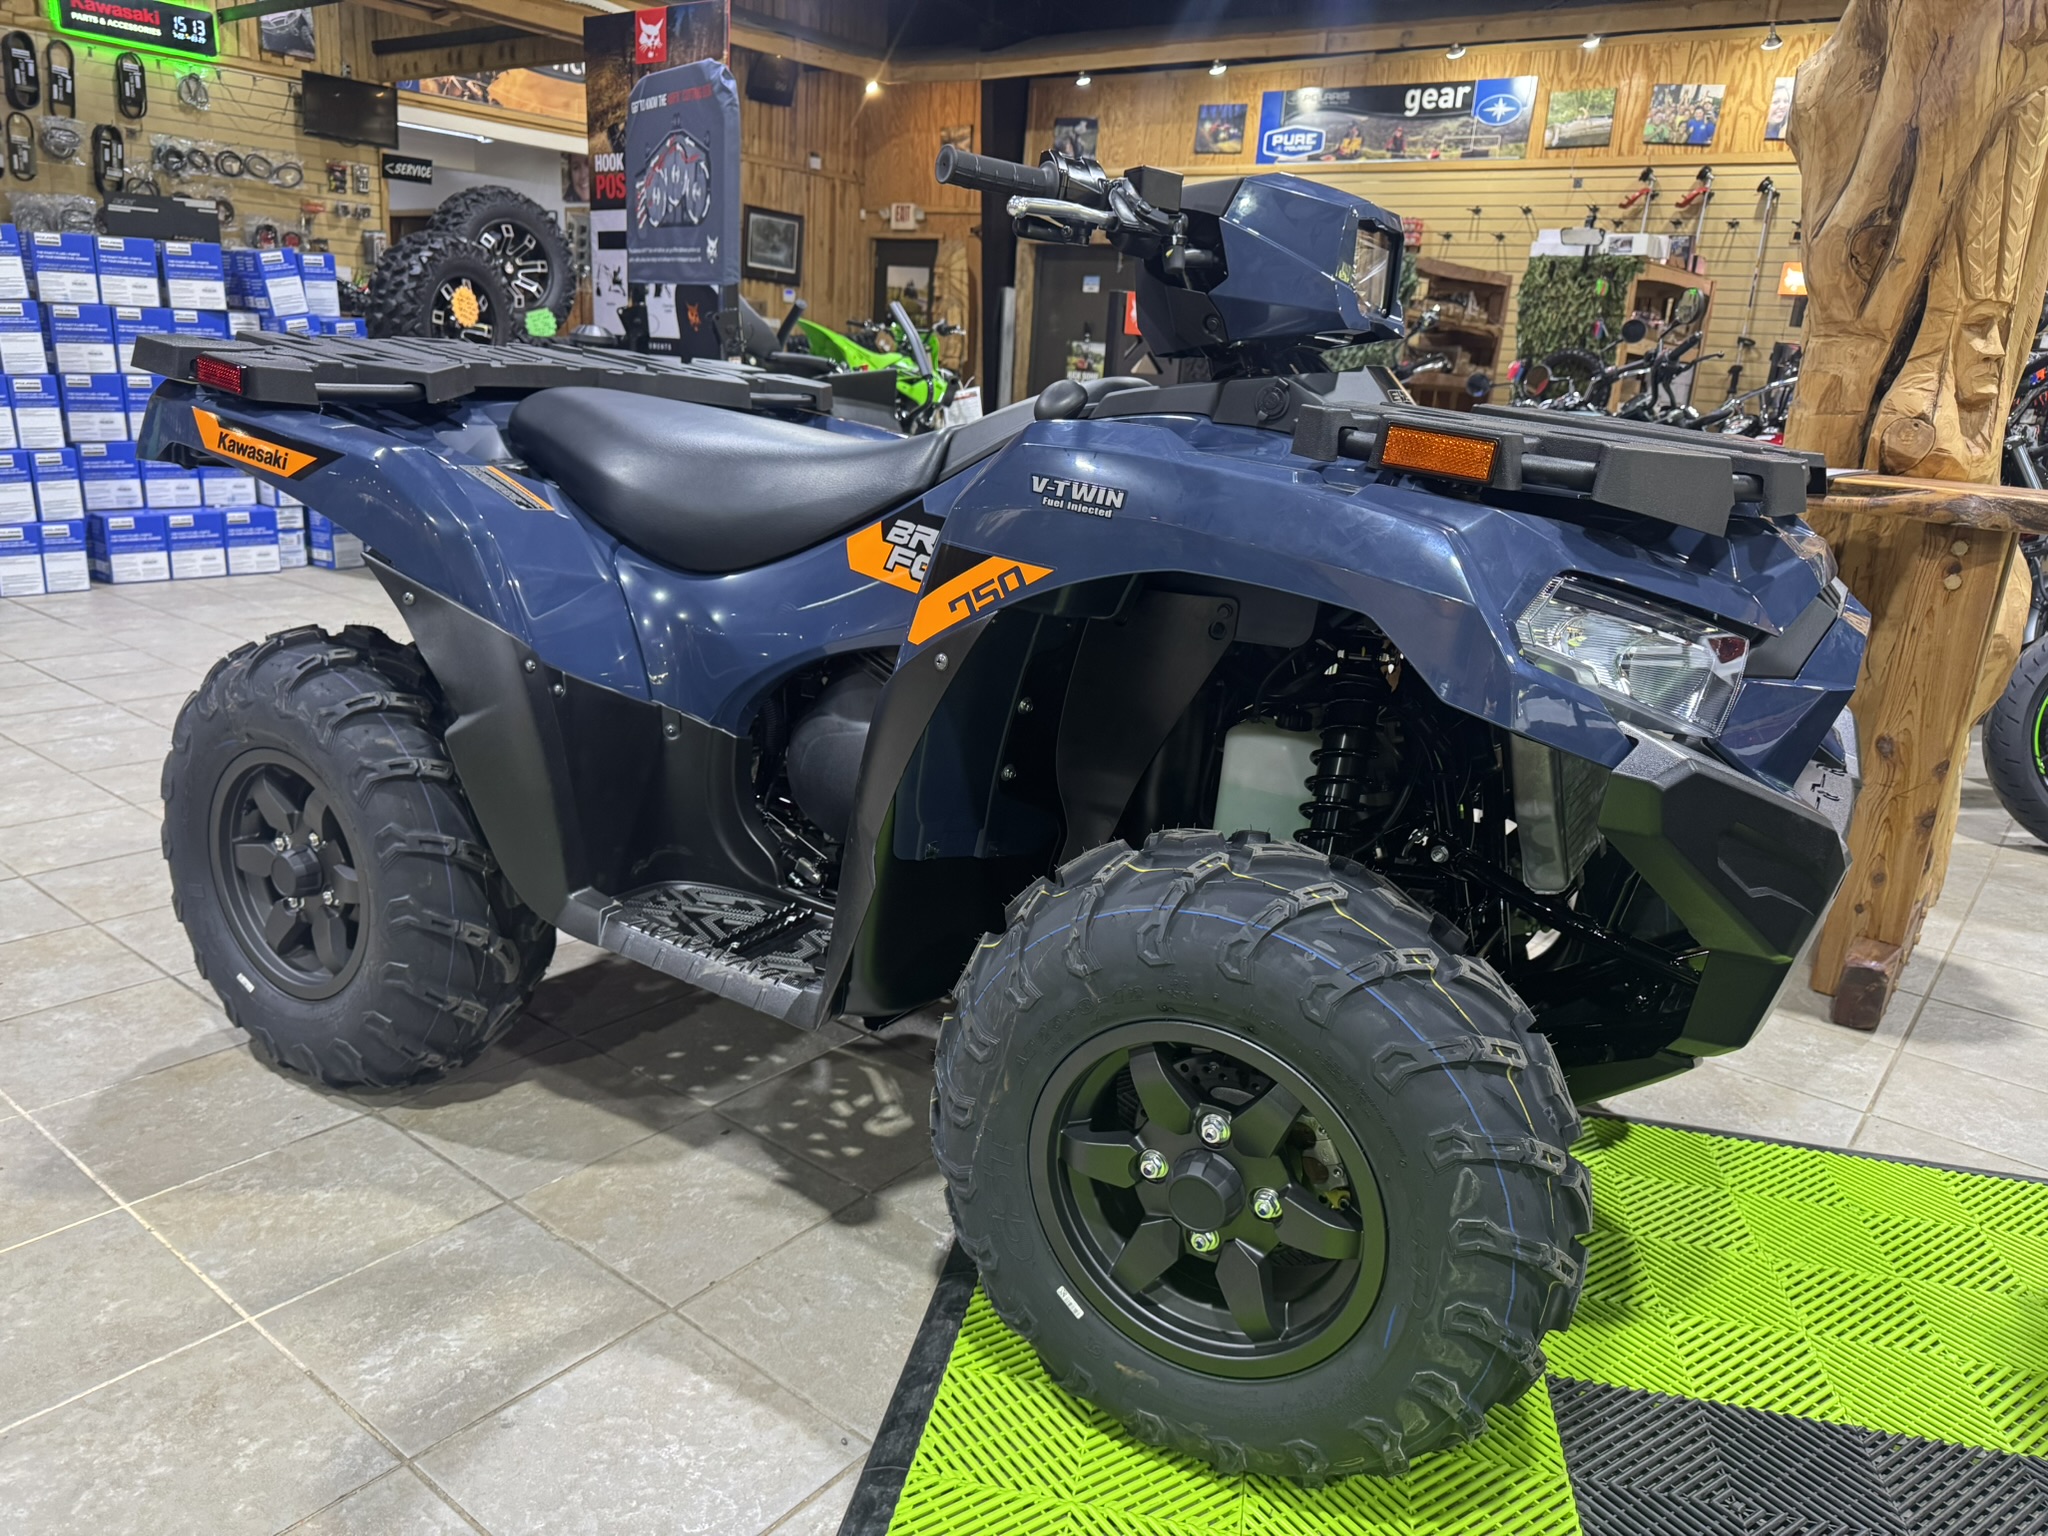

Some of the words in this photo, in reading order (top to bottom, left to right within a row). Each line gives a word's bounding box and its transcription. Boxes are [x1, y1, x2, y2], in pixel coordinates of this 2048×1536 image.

[70, 11, 99, 24] PARTS
[107, 18, 162, 37] ACCESSORIES
[1403, 85, 1472, 117] gear
[1271, 132, 1318, 147] PURE
[394, 162, 433, 179] SERVICE
[594, 152, 625, 173] HOOK
[895, 205, 911, 223] EXIT
[217, 431, 289, 471] Kawasaki
[1031, 475, 1125, 509] V-TWIN
[1042, 496, 1065, 509] Fuel
[1066, 501, 1113, 519] Injected
[947, 565, 1028, 617] 750
